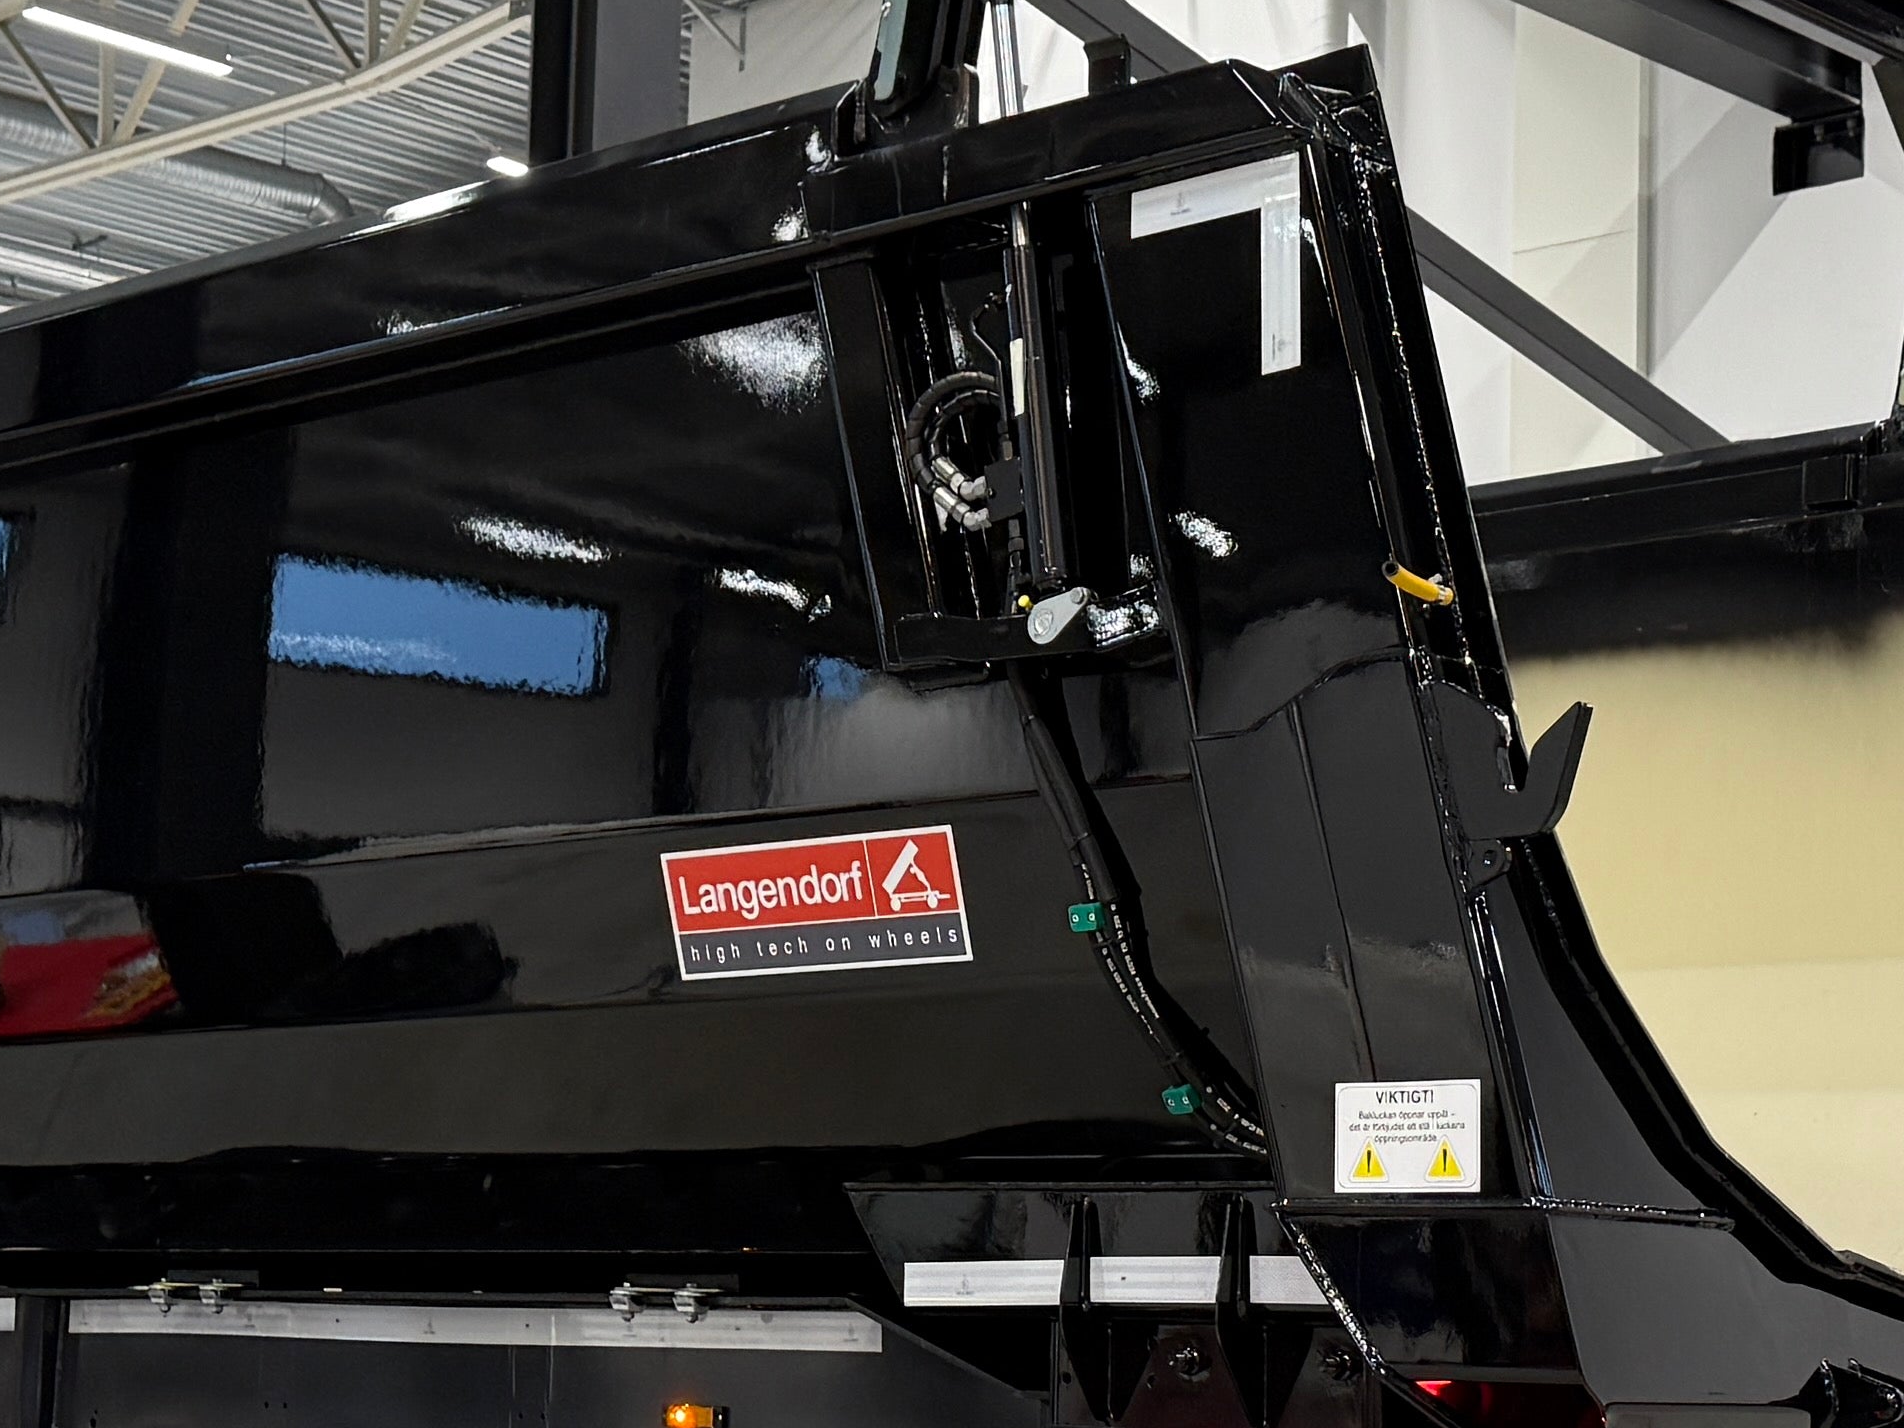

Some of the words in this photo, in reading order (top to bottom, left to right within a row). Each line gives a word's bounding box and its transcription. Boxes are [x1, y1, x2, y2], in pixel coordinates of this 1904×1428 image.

[678, 859, 863, 919] Langendorf
[690, 943, 740, 963] high
[756, 935, 809, 957] tech
[825, 935, 852, 952] on
[867, 926, 959, 949] wheels
